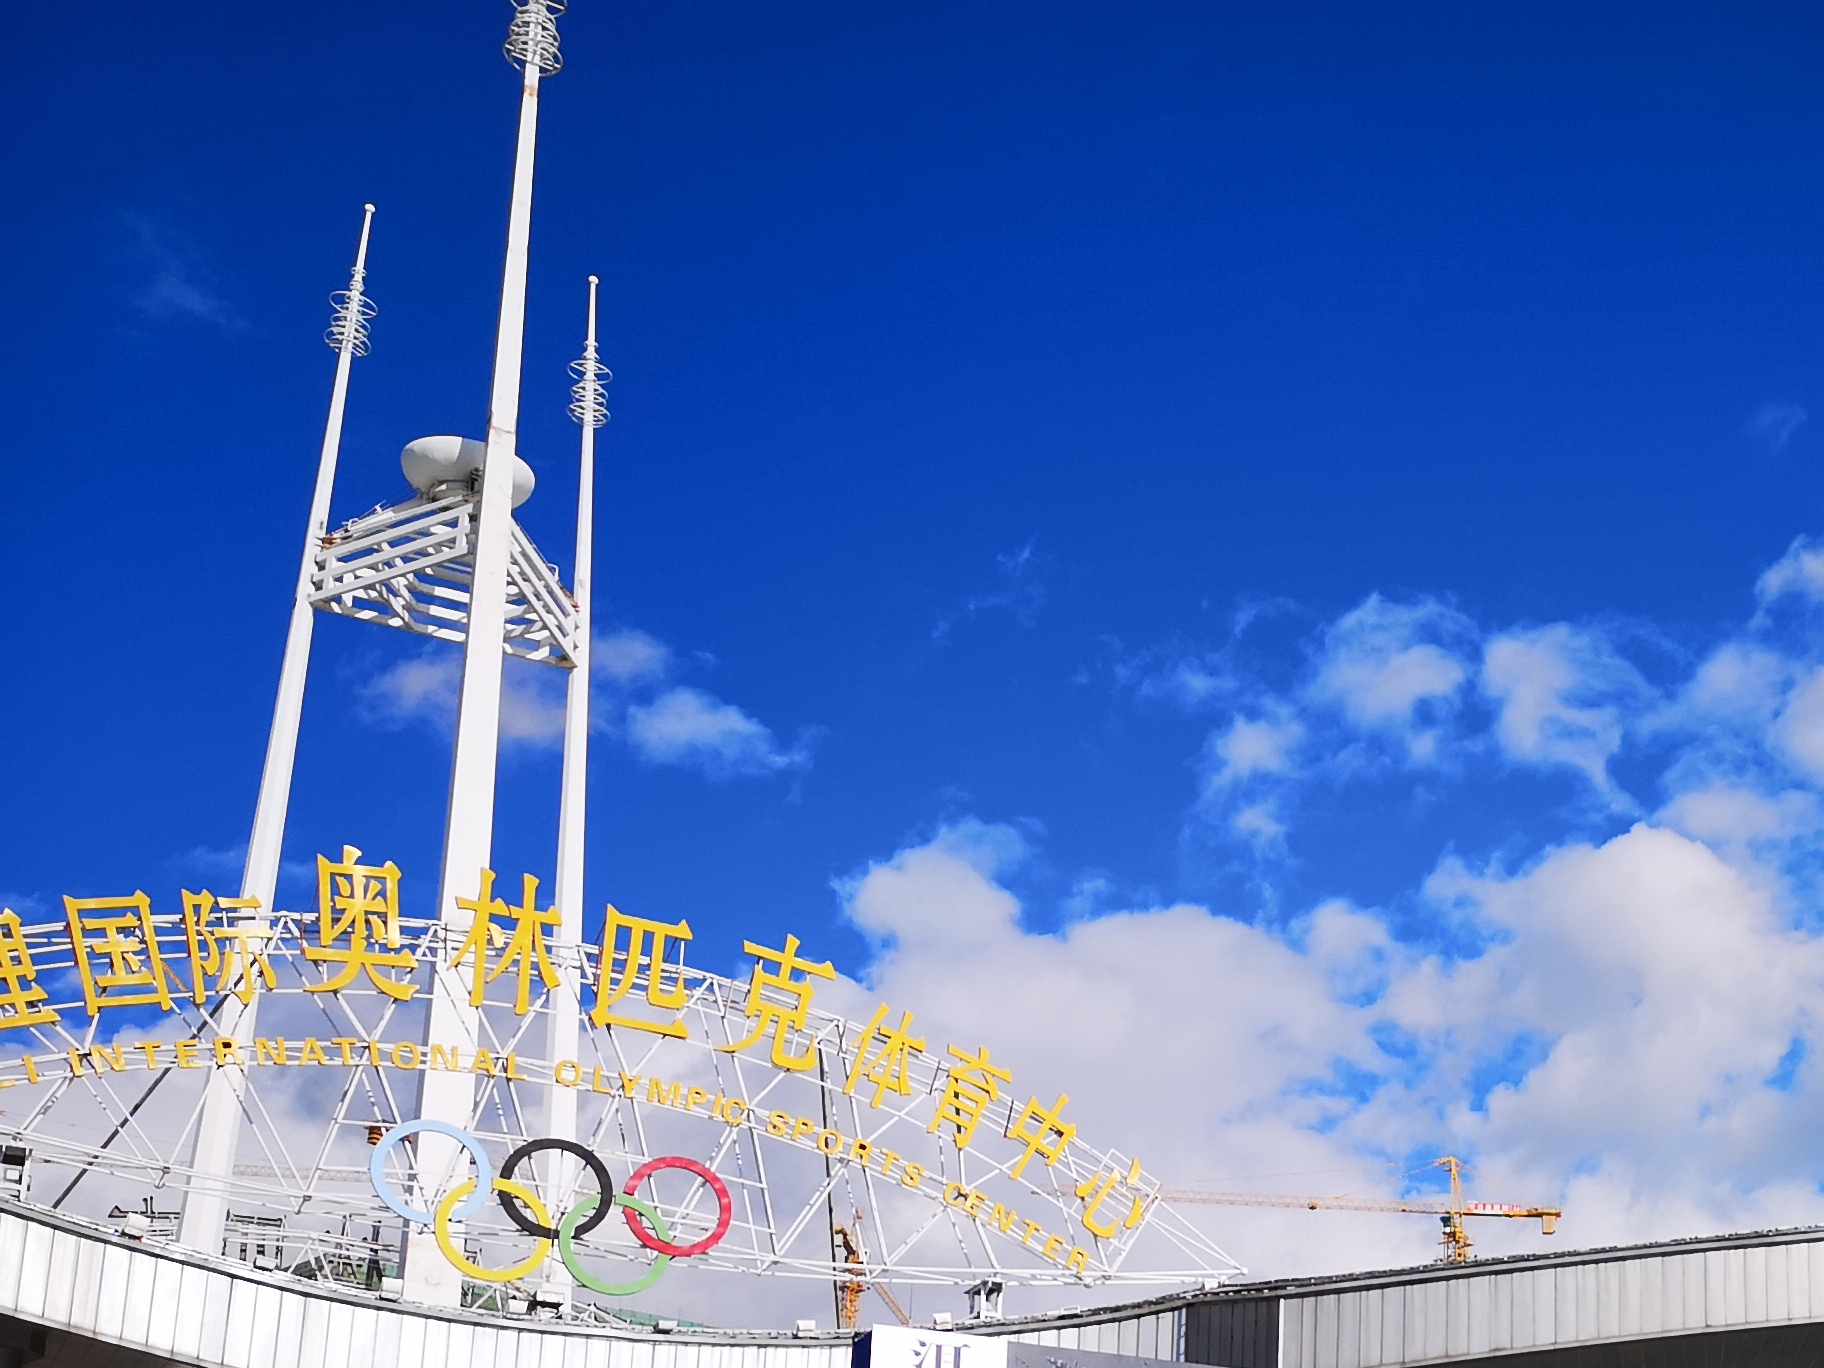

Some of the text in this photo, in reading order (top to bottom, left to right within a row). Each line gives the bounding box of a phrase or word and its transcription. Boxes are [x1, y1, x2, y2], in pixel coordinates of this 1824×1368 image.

[67, 1036, 527, 1082] INTERNATIONAL
[554, 1059, 748, 1126] OLYMPIC
[765, 1110, 926, 1187] SPORTS
[943, 1181, 1091, 1276] CENTER
